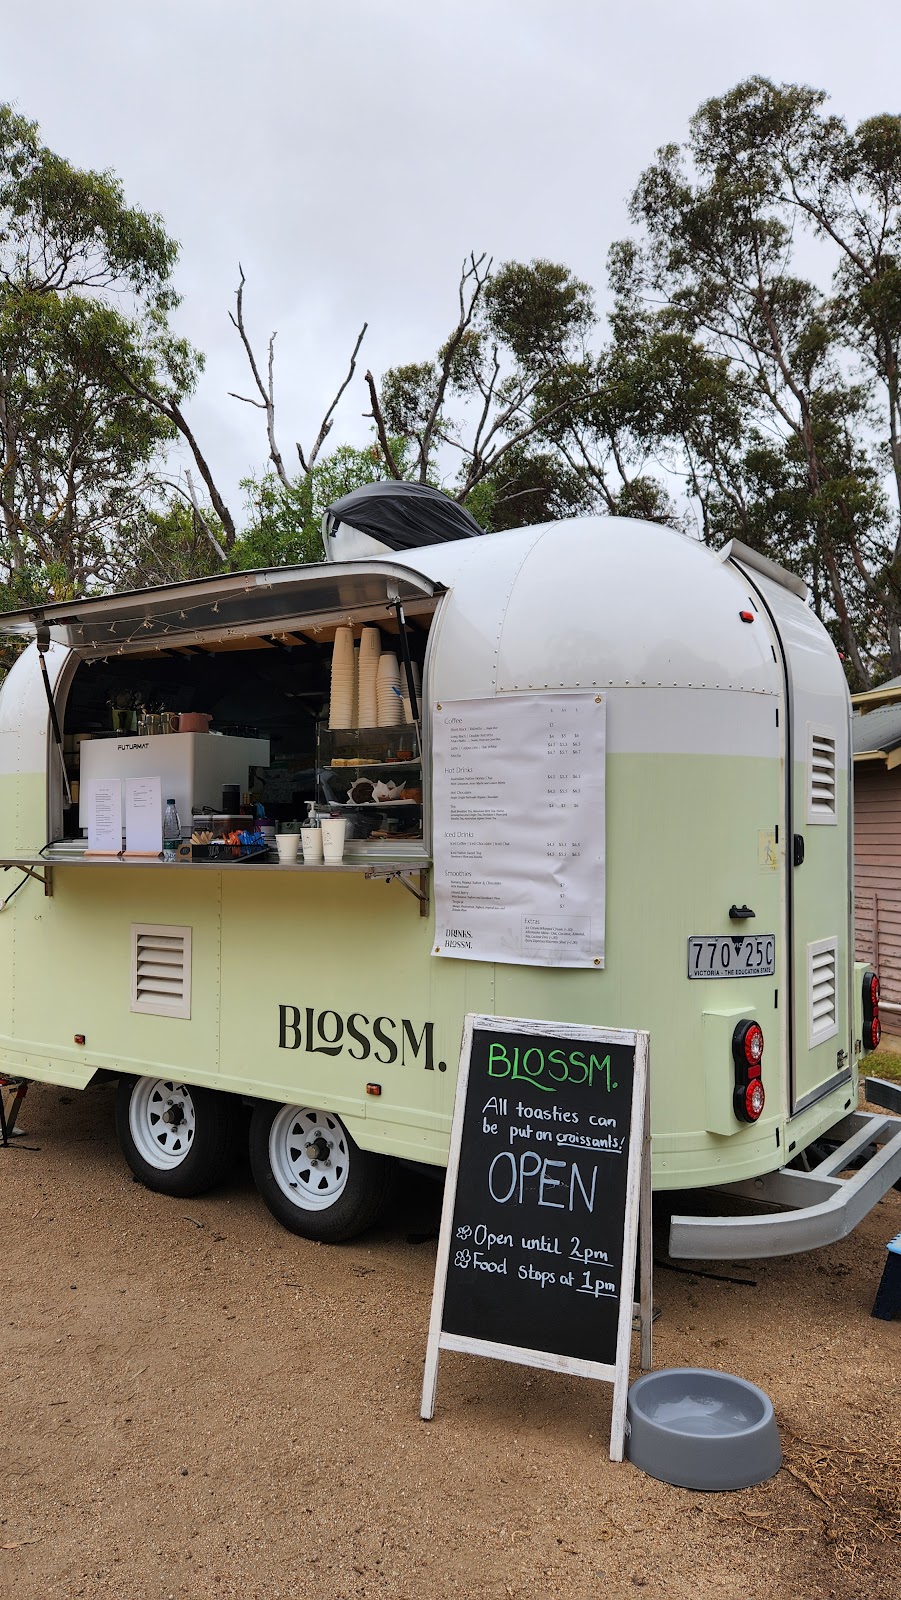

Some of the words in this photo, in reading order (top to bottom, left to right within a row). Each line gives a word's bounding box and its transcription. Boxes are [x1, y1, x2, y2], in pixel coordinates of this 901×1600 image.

[444, 717, 463, 725] Coffee
[117, 743, 149, 751] FUTURMAT
[444, 869, 472, 877] Smoothies
[445, 928, 473, 939] DRINKS.
[524, 917, 540, 925] Extras
[444, 939, 473, 949] BLOSSM.
[693, 943, 730, 968] 770
[745, 941, 773, 967] 25C
[278, 1004, 447, 1072] BLOSSM.
[487, 1043, 619, 1092] BLOSSM.
[482, 1096, 508, 1116] All
[516, 1101, 579, 1124] toasties
[589, 1115, 617, 1128] can
[482, 1117, 499, 1134] be
[509, 1125, 534, 1145] put
[536, 1130, 553, 1142] on
[488, 1151, 598, 1213] OPEN
[474, 1224, 514, 1250] Open
[521, 1235, 562, 1255] until
[568, 1236, 609, 1264] 2pm
[473, 1252, 508, 1275] Food
[559, 1272, 575, 1287] at
[580, 1270, 616, 1298] 1pm
